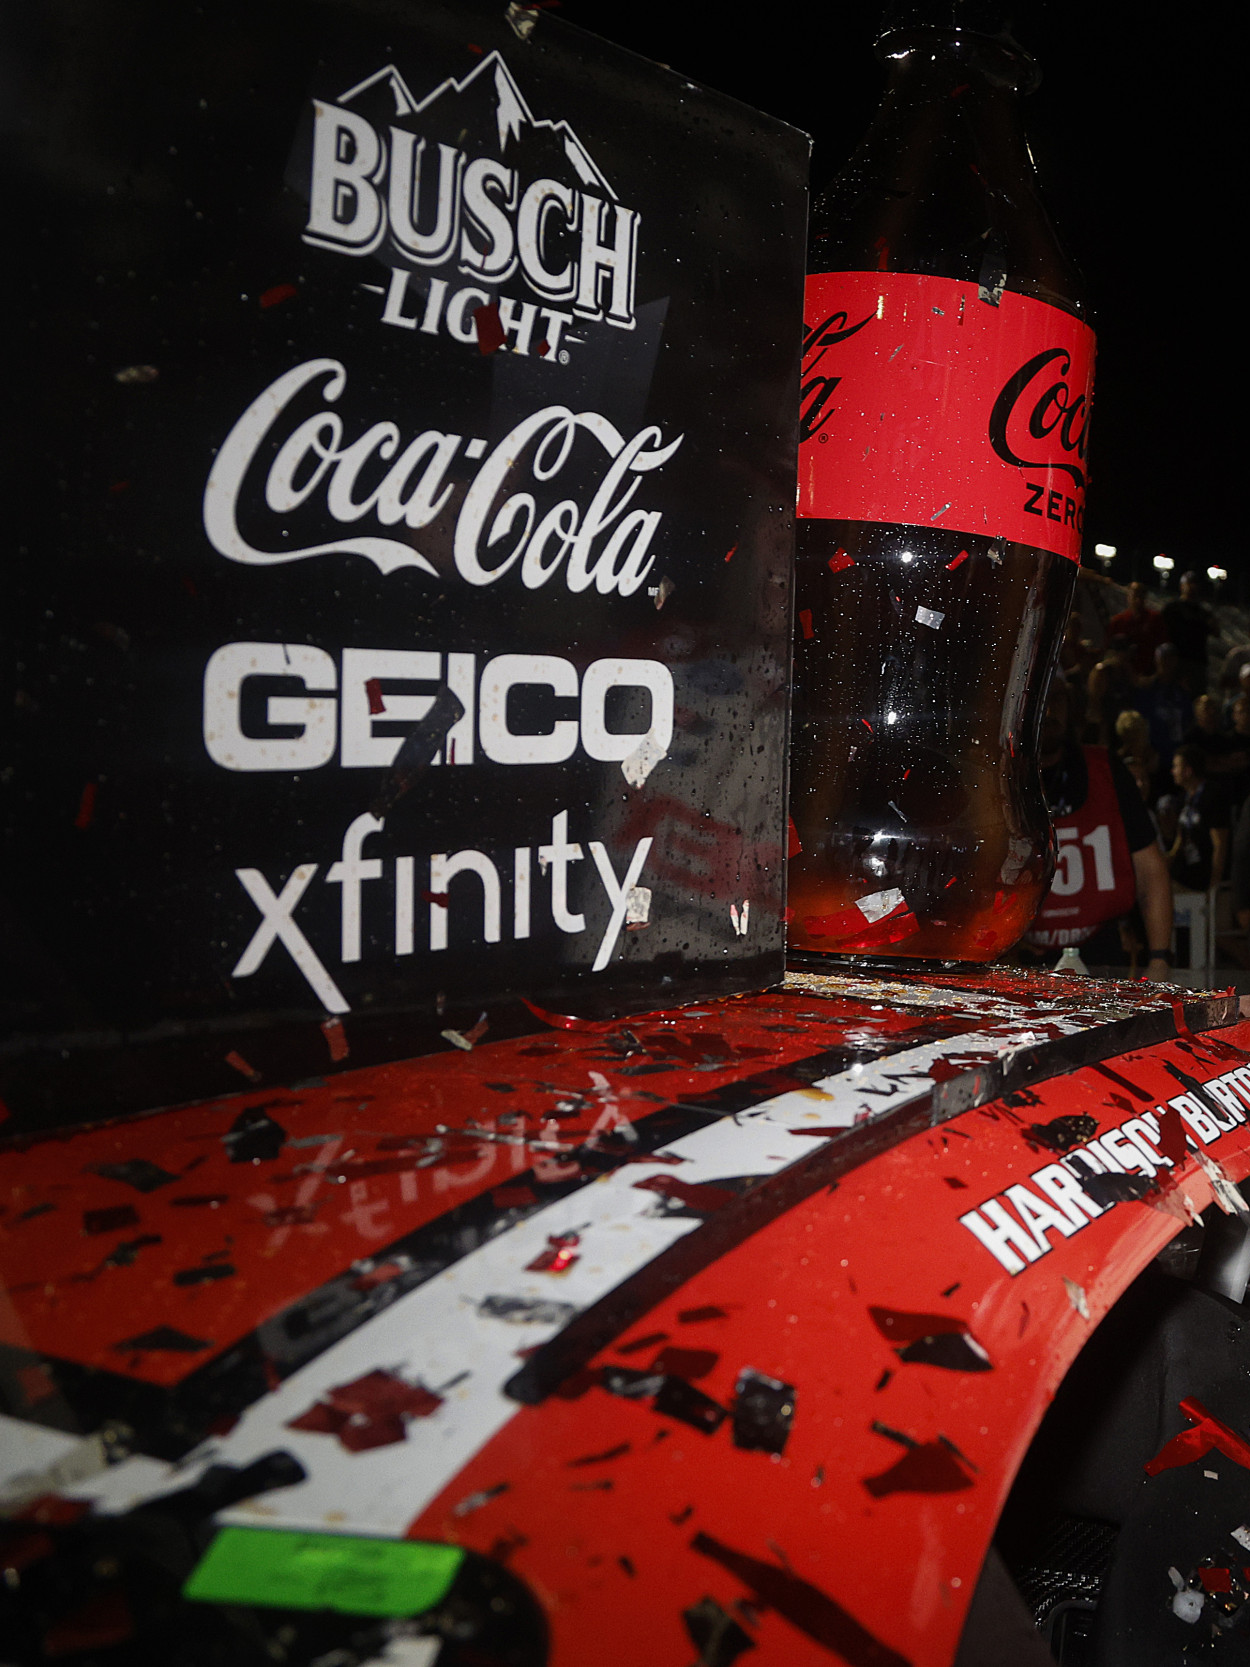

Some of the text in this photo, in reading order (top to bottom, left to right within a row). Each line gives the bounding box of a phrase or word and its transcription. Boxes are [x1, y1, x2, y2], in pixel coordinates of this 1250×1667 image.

[300, 99, 641, 330] BUSCH
[380, 266, 574, 363] LIGHT
[203, 358, 685, 597] Coca-Cola
[203, 641, 675, 772] GEICO
[231, 810, 653, 1014] xfinity
